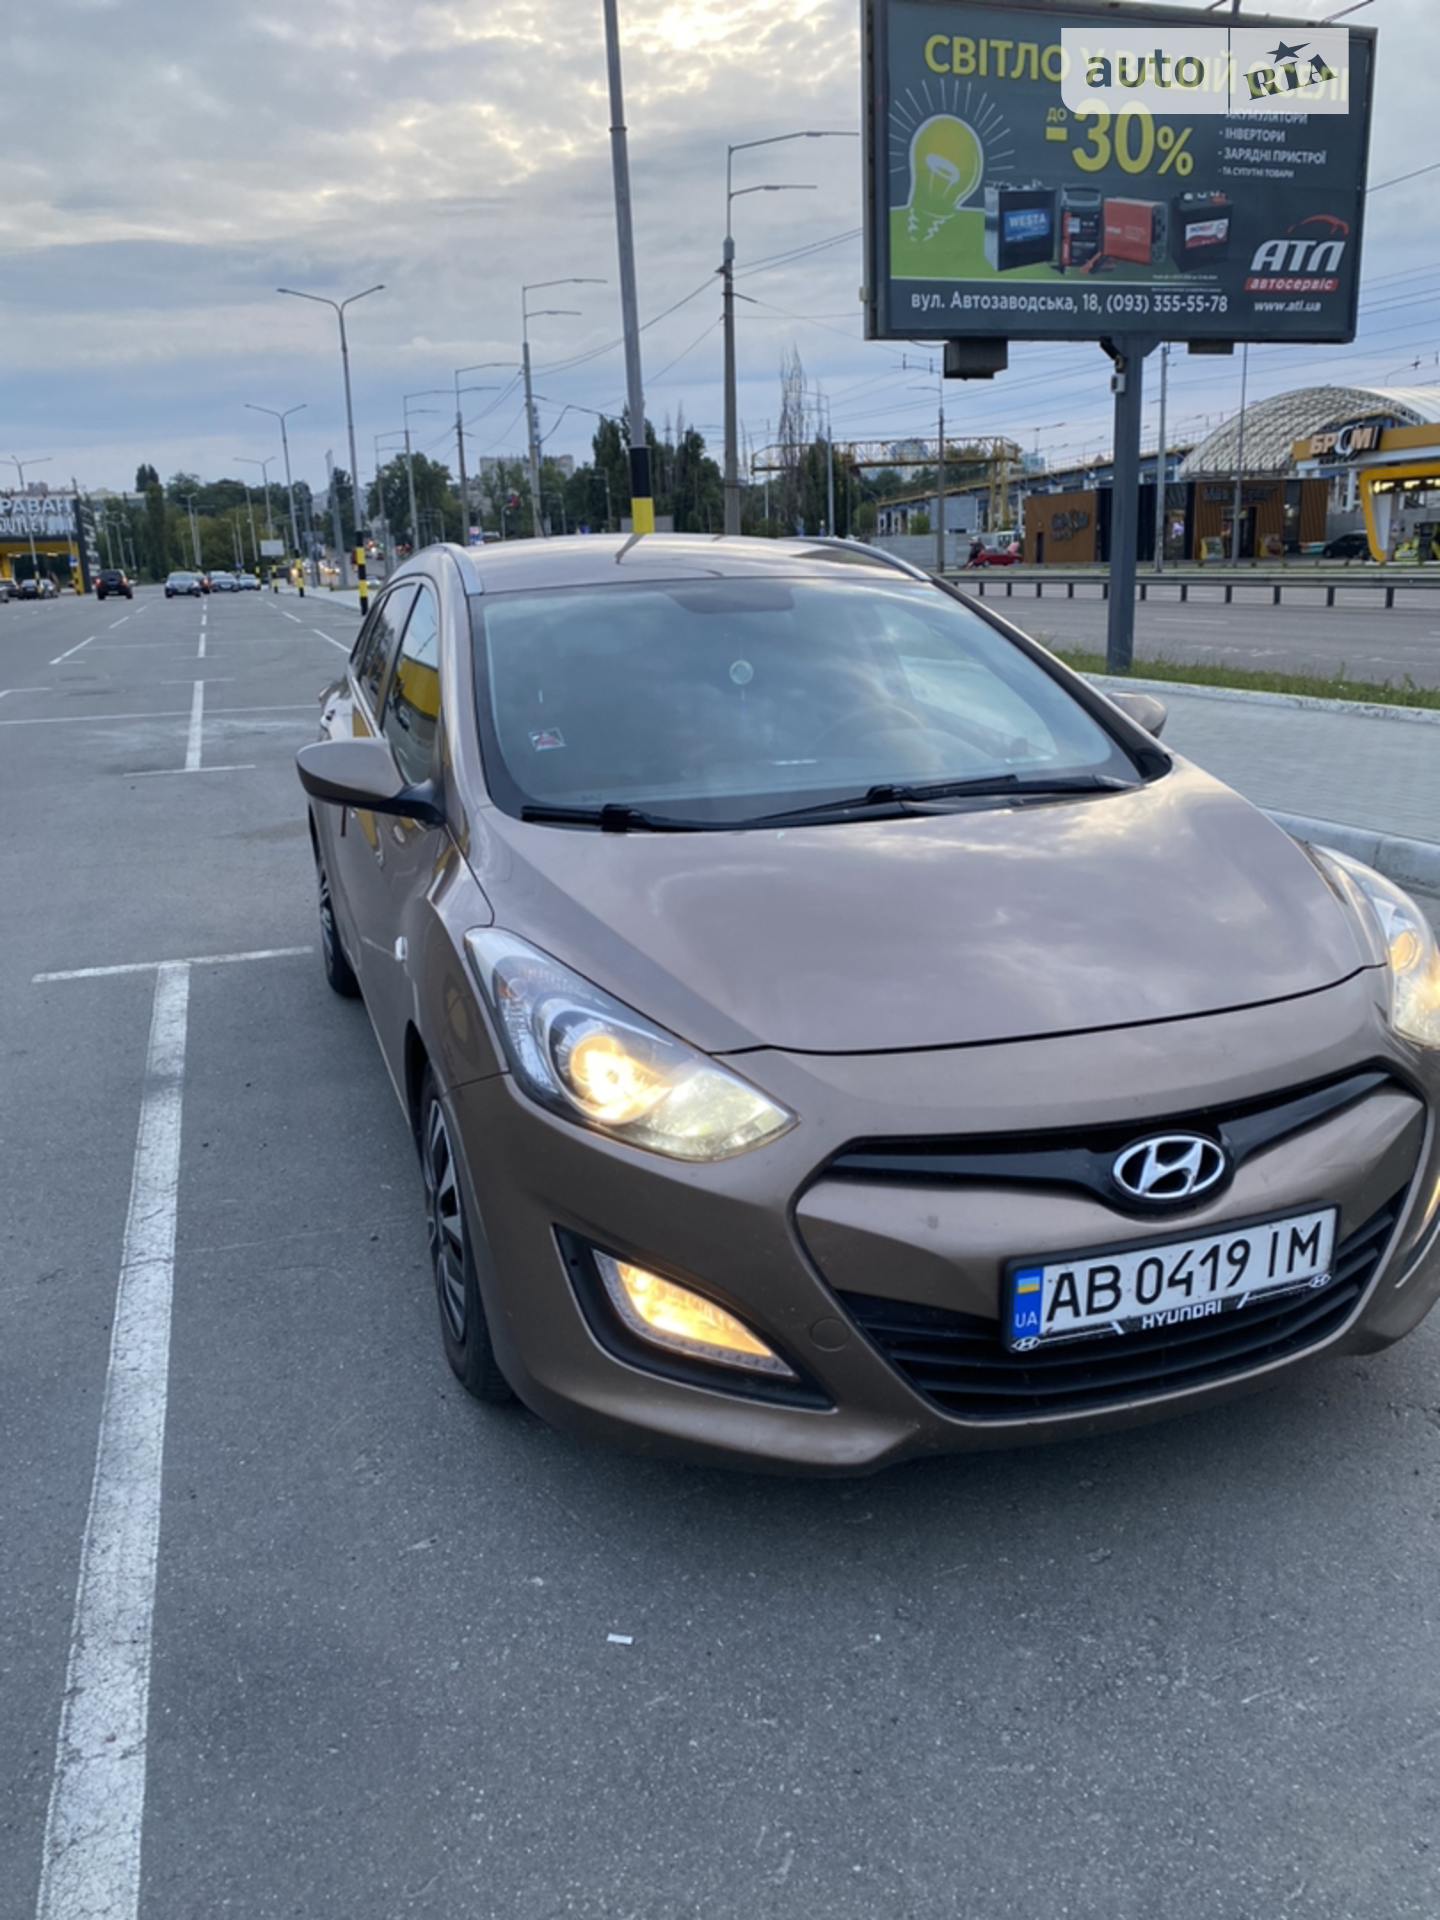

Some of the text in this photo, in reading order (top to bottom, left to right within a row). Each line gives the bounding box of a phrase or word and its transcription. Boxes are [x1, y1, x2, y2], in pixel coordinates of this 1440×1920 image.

[924, 33, 1071, 82] СВІТЛО
[1045, 97, 1194, 177] -30%
[1225, 127, 1286, 143] ІНВЕРТОРИ
[1224, 147, 1327, 165] ЗАРЯДНІ ПРИСТРОЇ
[1009, 213, 1047, 229] WESTA
[1250, 239, 1346, 272] АТЛ
[1250, 277, 1334, 292] автосервіс
[911, 291, 1228, 314] вул. Автозаводська, 18, (093) 355-55-78
[1254, 300, 1322, 312] www.atl.ua
[1046, 1220, 1323, 1323] AB 0419 IM
[1014, 1310, 1039, 1329] UA
[1141, 1299, 1223, 1330] HYUNDAI
